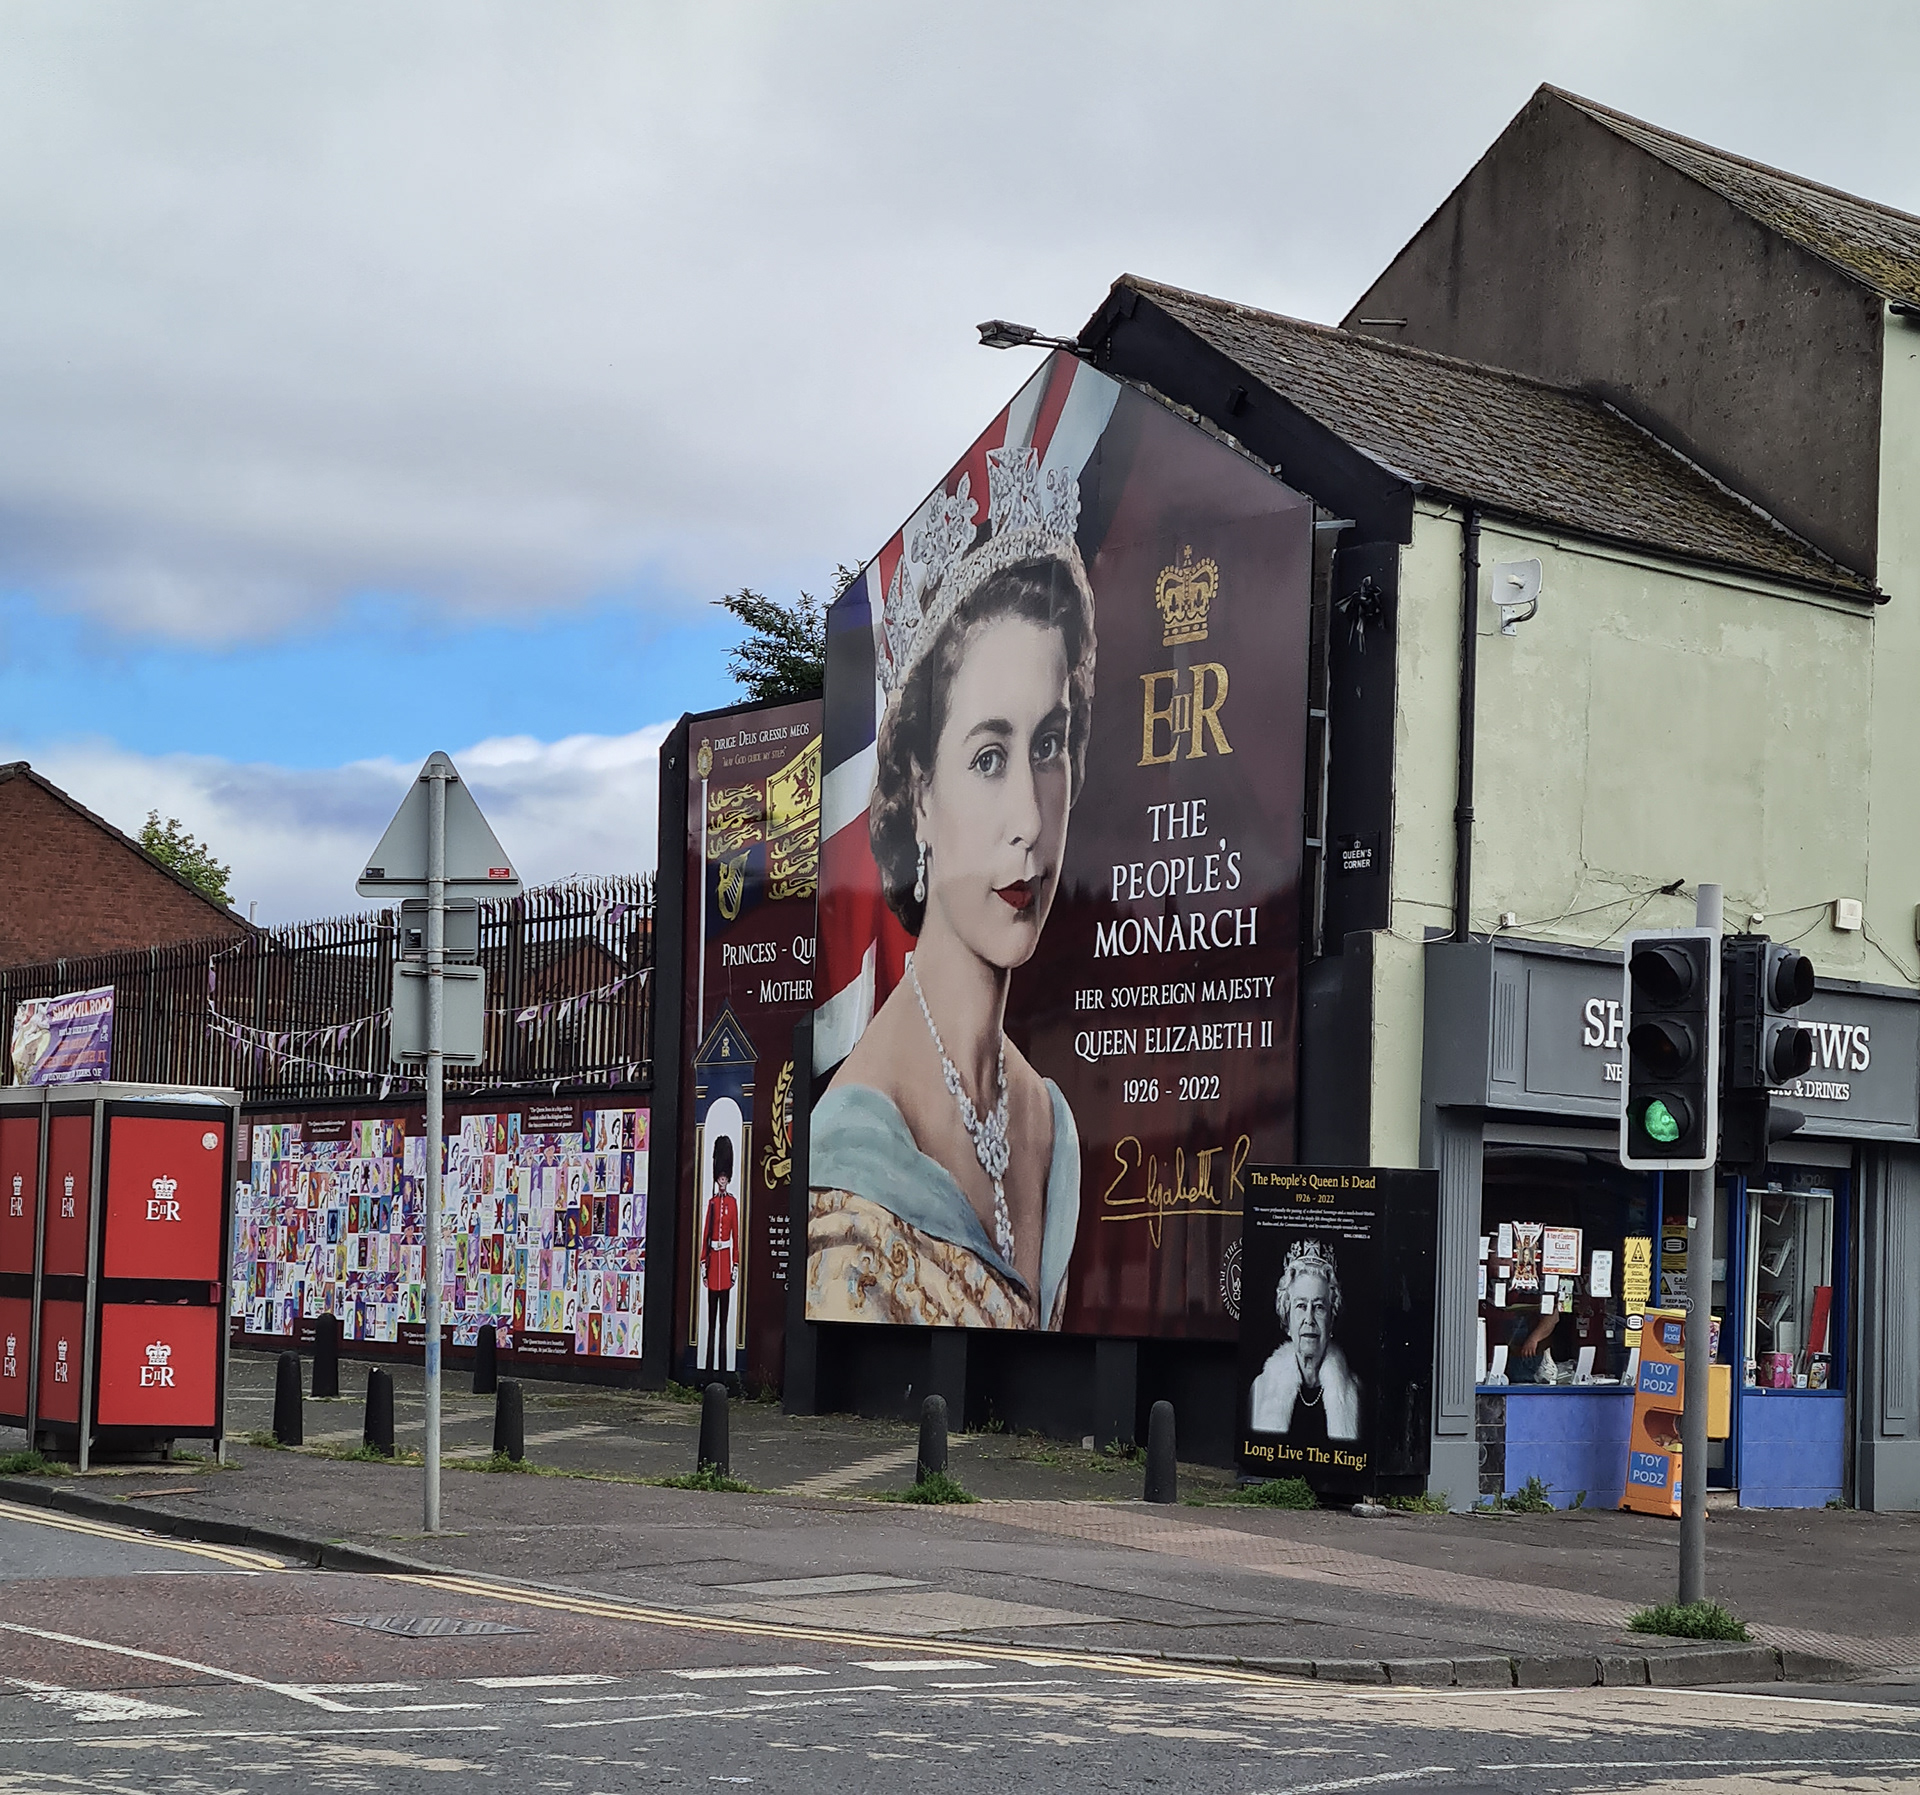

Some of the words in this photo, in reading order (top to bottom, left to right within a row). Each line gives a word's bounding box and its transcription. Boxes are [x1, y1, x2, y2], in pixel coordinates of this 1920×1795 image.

[714, 736, 736, 751] DIRIGE
[759, 726, 788, 743] GRESSUS
[790, 723, 810, 738] MEOS
[1147, 799, 1208, 842] THE
[1342, 848, 1372, 860] QUEEN'S
[1343, 859, 1371, 869] CORNER
[1111, 838, 1241, 902] PEOPLE'S
[1093, 907, 1258, 958] MONARCH
[722, 942, 777, 967] PRINCESS
[759, 980, 814, 1003] MOTHER
[1075, 989, 1105, 1010] HER
[1111, 982, 1196, 1008] SOVEREIGN
[1201, 976, 1275, 1003] MAJESTY
[1075, 1028, 1137, 1063] QUEEN
[1144, 1021, 1252, 1054] ELIZABETH
[1261, 1020, 1273, 1048] II
[1123, 1078, 1159, 1103] 1926
[1178, 1075, 1220, 1101] 2022
[1805, 1080, 1850, 1100] DRINKS
[1251, 1172, 1268, 1185] The
[1270, 1173, 1307, 1190] People's
[1309, 1174, 1338, 1190] Queen
[1341, 1175, 1349, 1188] Is
[1352, 1175, 1376, 1189] Dead
[1295, 1193, 1311, 1203] 1926
[1317, 1194, 1335, 1204] 2022
[1649, 1362, 1672, 1376] TOY
[1642, 1379, 1675, 1394] PODZ
[1244, 1441, 1274, 1461] Long
[1278, 1444, 1303, 1460] Live
[1307, 1447, 1331, 1463] The
[1334, 1450, 1367, 1471] King!
[1639, 1453, 1662, 1468] TOY
[1632, 1469, 1665, 1485] PODZ
